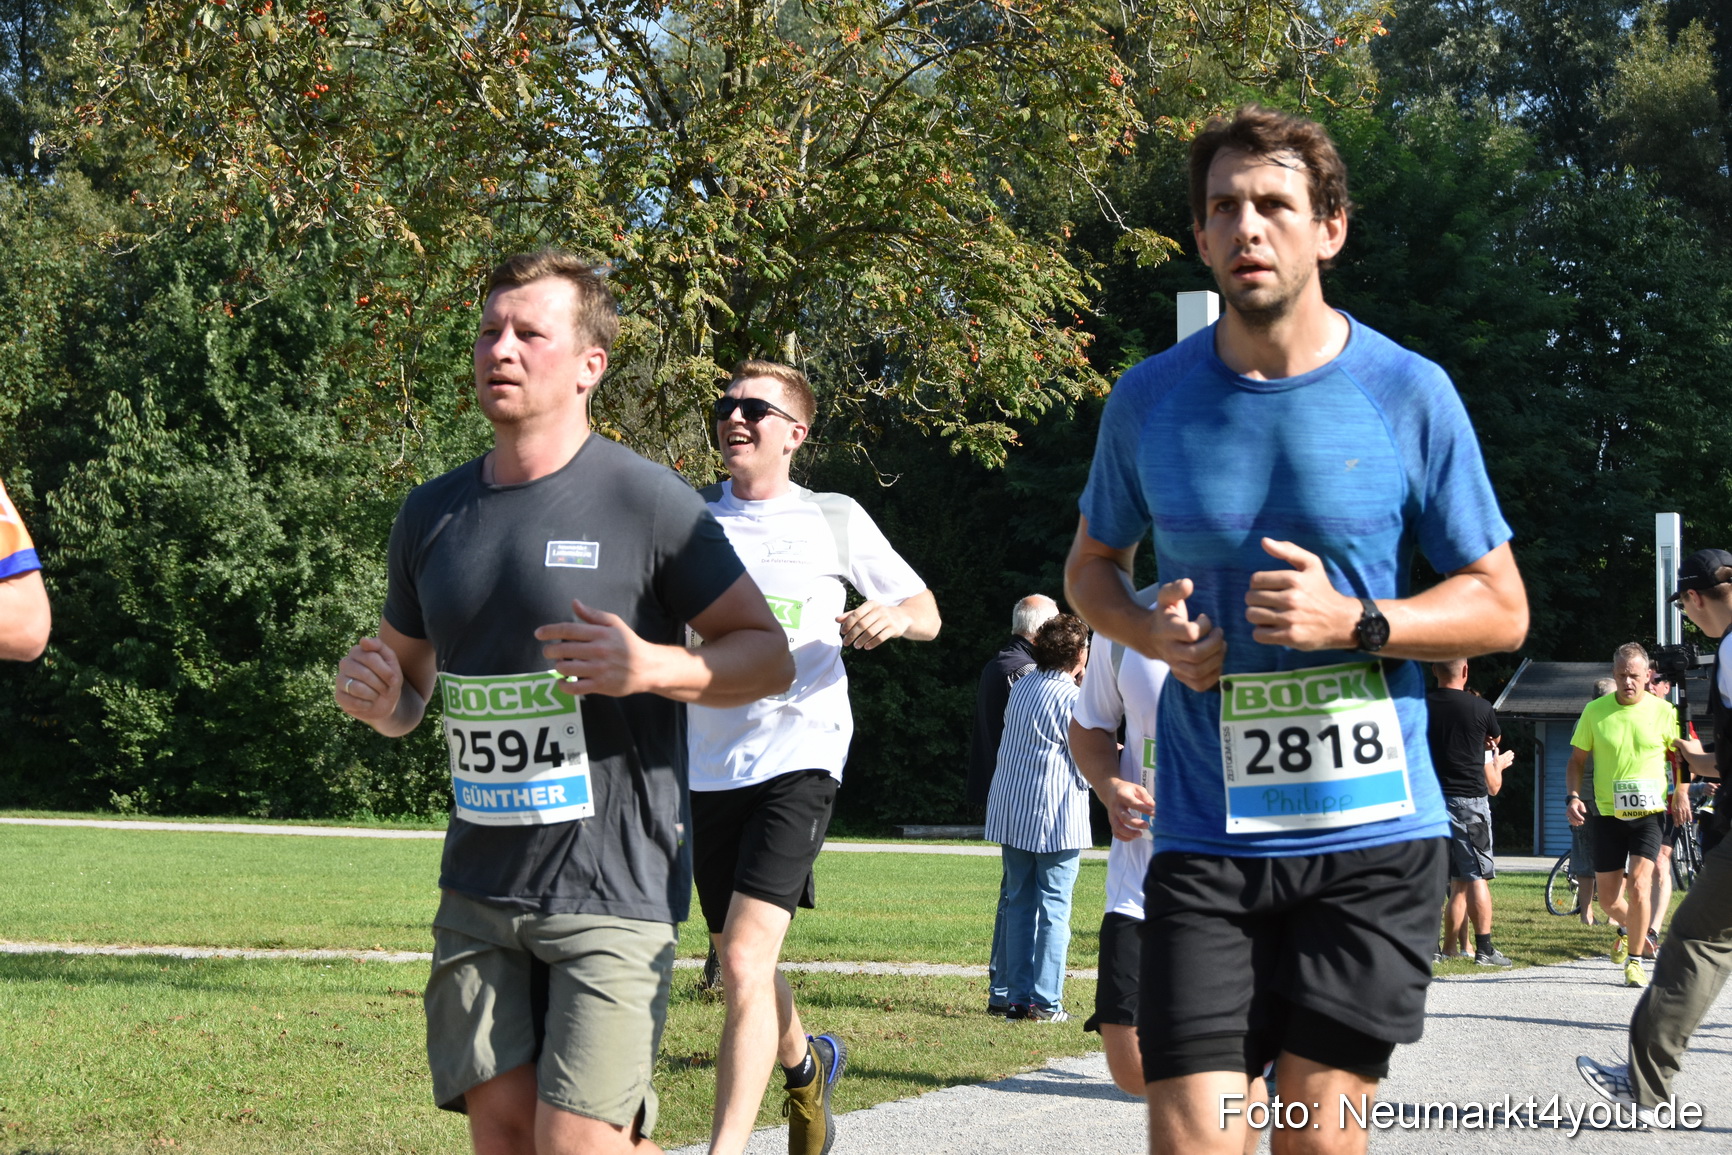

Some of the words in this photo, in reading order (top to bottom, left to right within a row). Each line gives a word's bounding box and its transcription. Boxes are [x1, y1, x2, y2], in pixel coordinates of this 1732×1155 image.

[447, 681, 559, 714] BOCK
[1233, 671, 1370, 715] BOCK
[452, 726, 565, 773] 2594
[1243, 721, 1383, 775] 2818
[462, 784, 567, 808] GÜNTHER
[1262, 787, 1353, 815] Philipp
[1620, 794, 1656, 807] 1031
